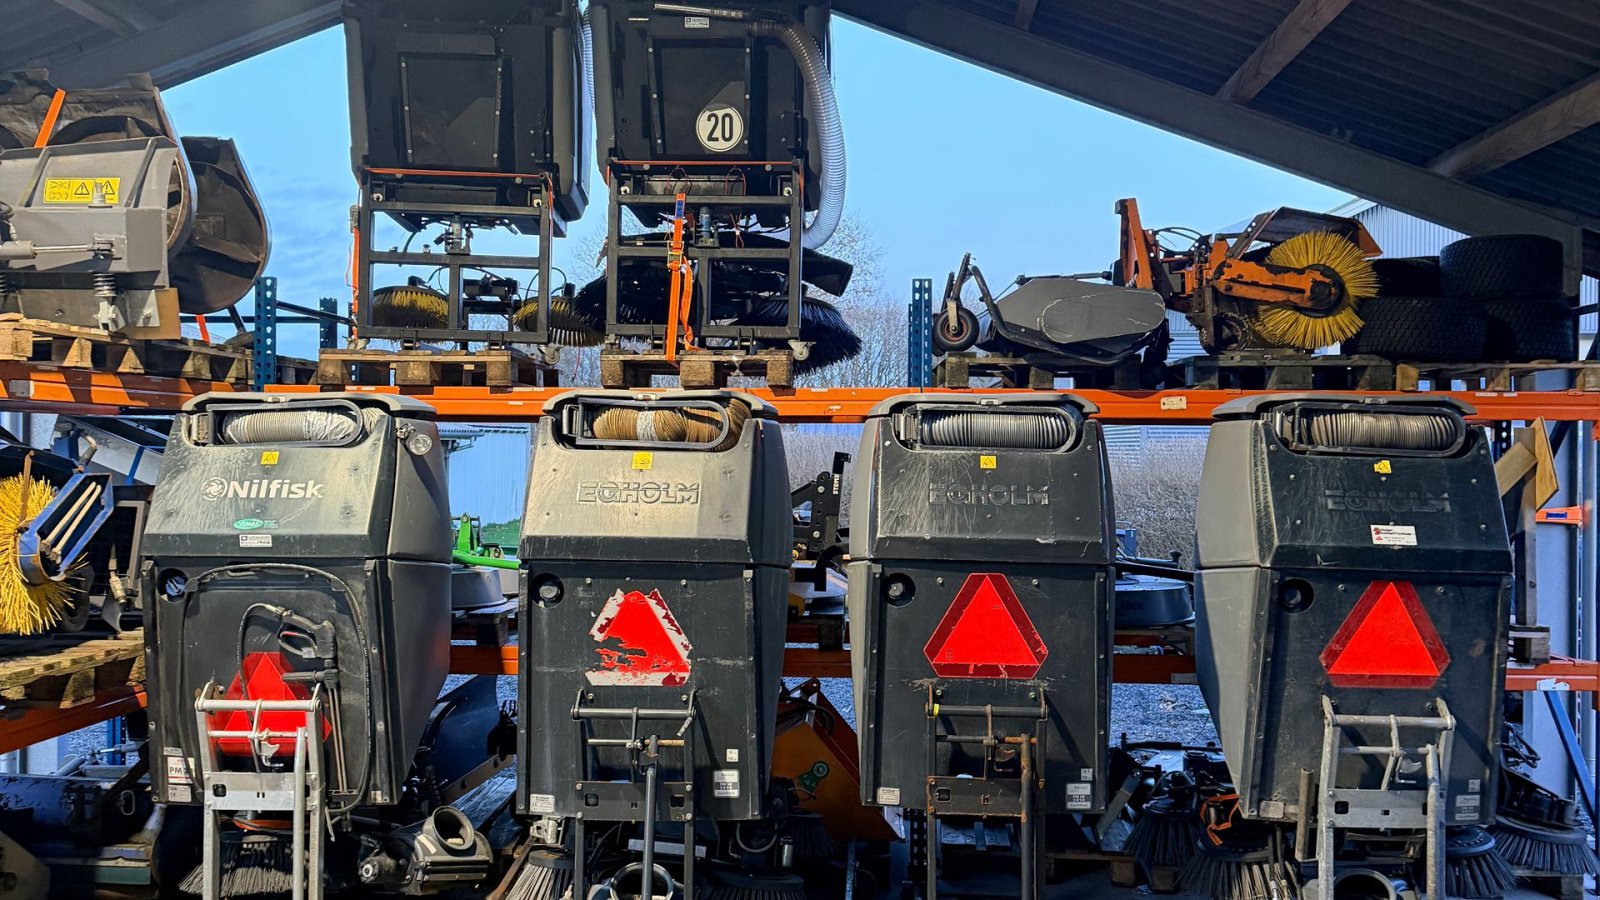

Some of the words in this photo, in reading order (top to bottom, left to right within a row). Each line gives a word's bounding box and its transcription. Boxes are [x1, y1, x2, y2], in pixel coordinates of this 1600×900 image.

[706, 112, 734, 142] 20
[226, 479, 324, 499] Nilfisk
[576, 481, 700, 504] EGHOLM
[929, 483, 1049, 505] EGHOLM
[1324, 489, 1452, 512] EGHOLM
